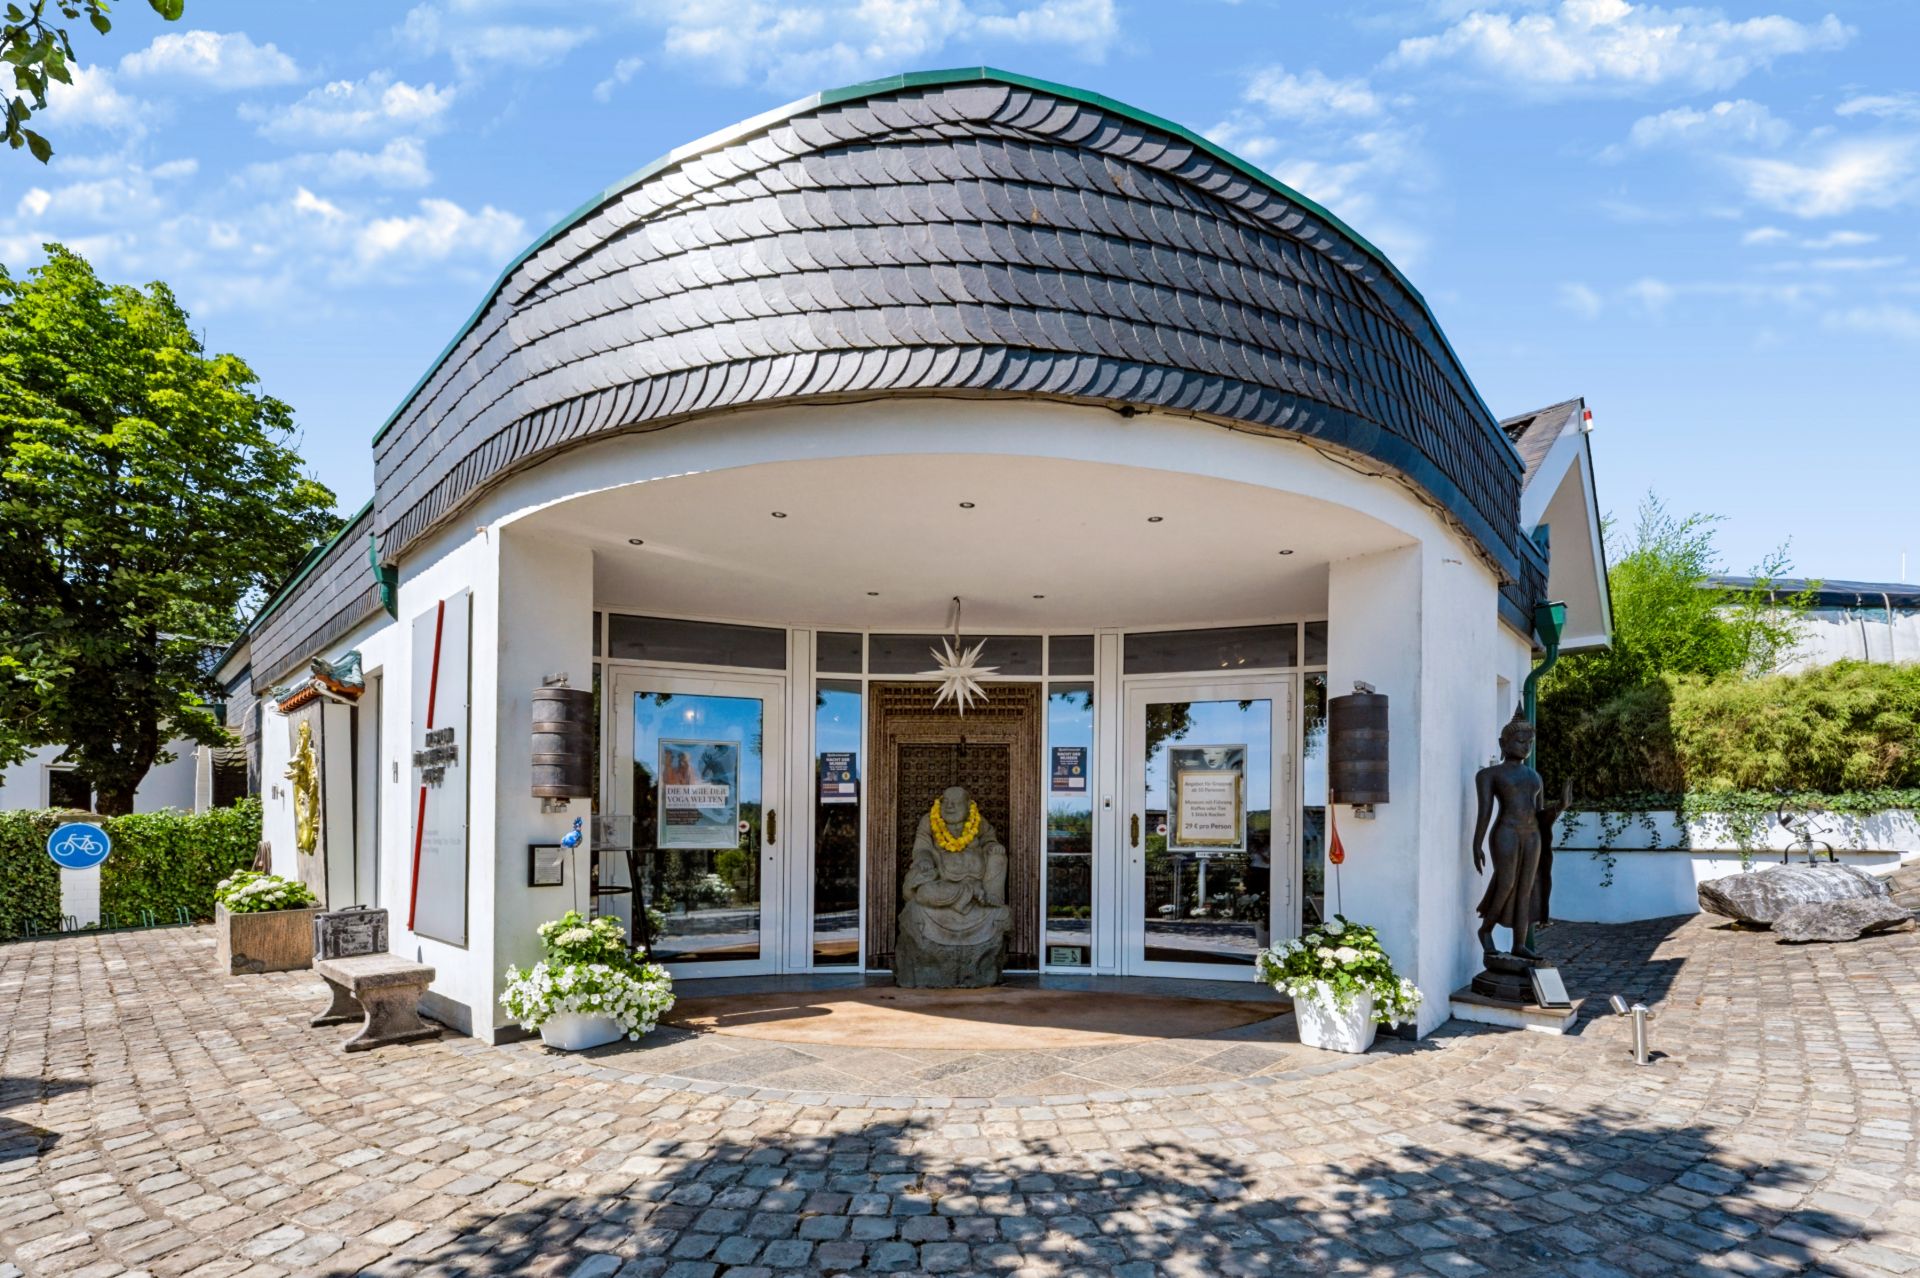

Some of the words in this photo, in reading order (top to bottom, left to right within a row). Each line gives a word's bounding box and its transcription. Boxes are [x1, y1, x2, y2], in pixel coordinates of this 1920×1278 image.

[667, 787, 680, 795] DIE
[683, 787, 708, 795] MAGIE
[710, 787, 726, 795] DER
